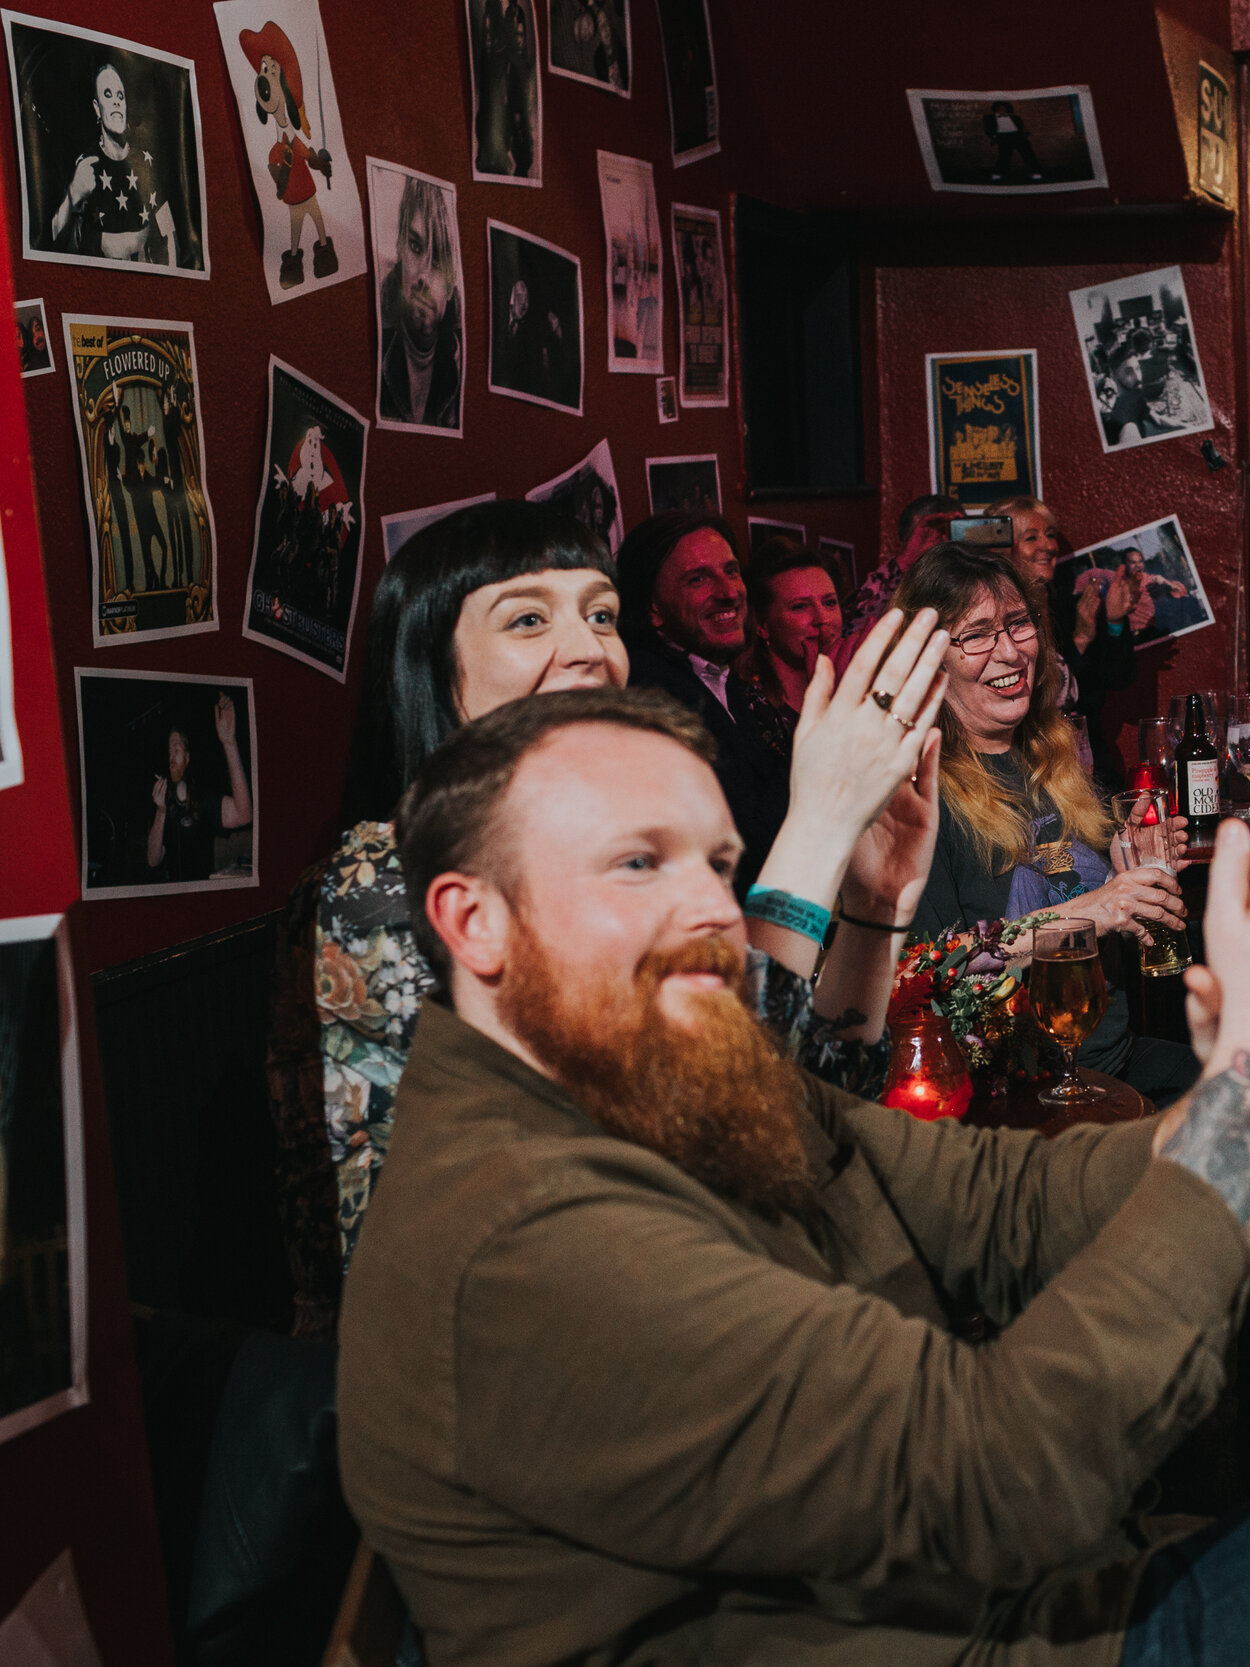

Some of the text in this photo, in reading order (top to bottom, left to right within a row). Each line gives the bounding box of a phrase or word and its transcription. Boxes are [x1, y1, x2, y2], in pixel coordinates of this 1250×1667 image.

[81, 335, 96, 348] best
[96, 335, 104, 348] of
[103, 351, 170, 381] FLOWERED UP
[942, 372, 1021, 396] SENSELESS
[948, 394, 1006, 416] THINGS
[1193, 788, 1214, 797] OLD
